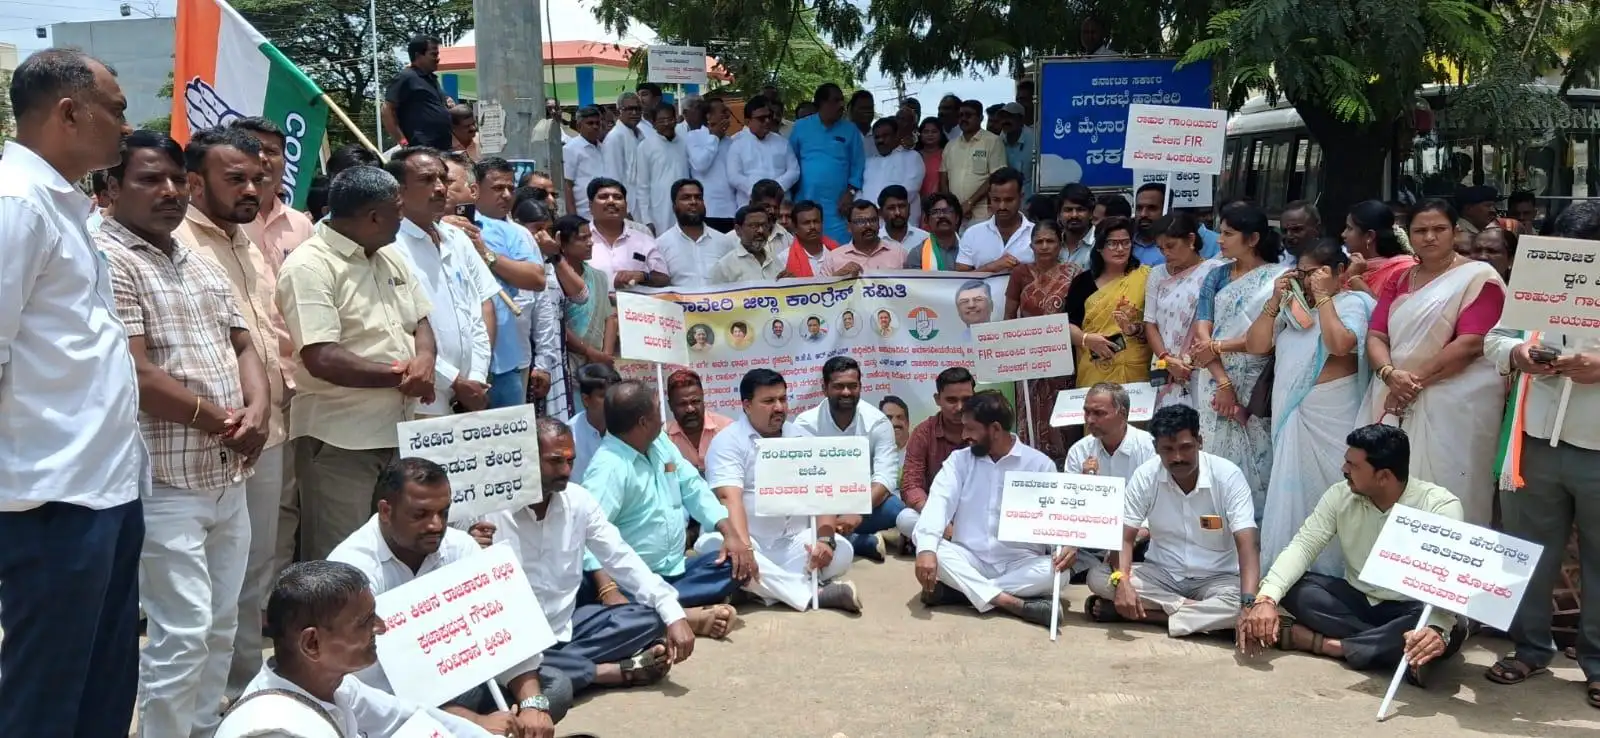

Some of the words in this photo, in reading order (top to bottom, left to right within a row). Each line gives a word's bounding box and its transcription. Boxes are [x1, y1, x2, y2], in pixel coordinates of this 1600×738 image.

[1091, 76, 1129, 86] ಕರ್ನಾಟಕ
[1132, 75, 1163, 85] ಸರ್ಕಾರ
[1072, 90, 1130, 108] ನಗರಸಭೆ
[1053, 118, 1071, 139] ಶ್ರೀ
[1184, 136, 1202, 147] FIR
[743, 295, 780, 314] ಜಿಲ್ಲಾ
[786, 285, 855, 307] ಕಾಂಗ್ರೆಸ್
[863, 282, 908, 299] ಸಮಿತಿ
[1514, 290, 1568, 303] ರಾಹುಲ್
[978, 349, 993, 360] FIR
[409, 428, 454, 450] ಸೇಡಿನ
[462, 418, 528, 442] ರಾಜಕೀಯ
[485, 449, 523, 468] ಕೇಂದ್ರ
[762, 448, 813, 460] ಸಂವಿಧಾನ
[798, 465, 827, 476] ಬಿಜೆಪಿ
[815, 483, 833, 497] ಪಕ್ಷ
[1420, 541, 1485, 568] ಜಾತಿವಾದ
[442, 572, 490, 603] ರಾಜಕಾರಣ
[1401, 575, 1470, 606] ಮನುವಾದ
[417, 613, 473, 655] ಪ್ರಜಾಪ್ರಭುತ್ವ
[436, 639, 482, 676] ಸಂವಿಧಾನ
